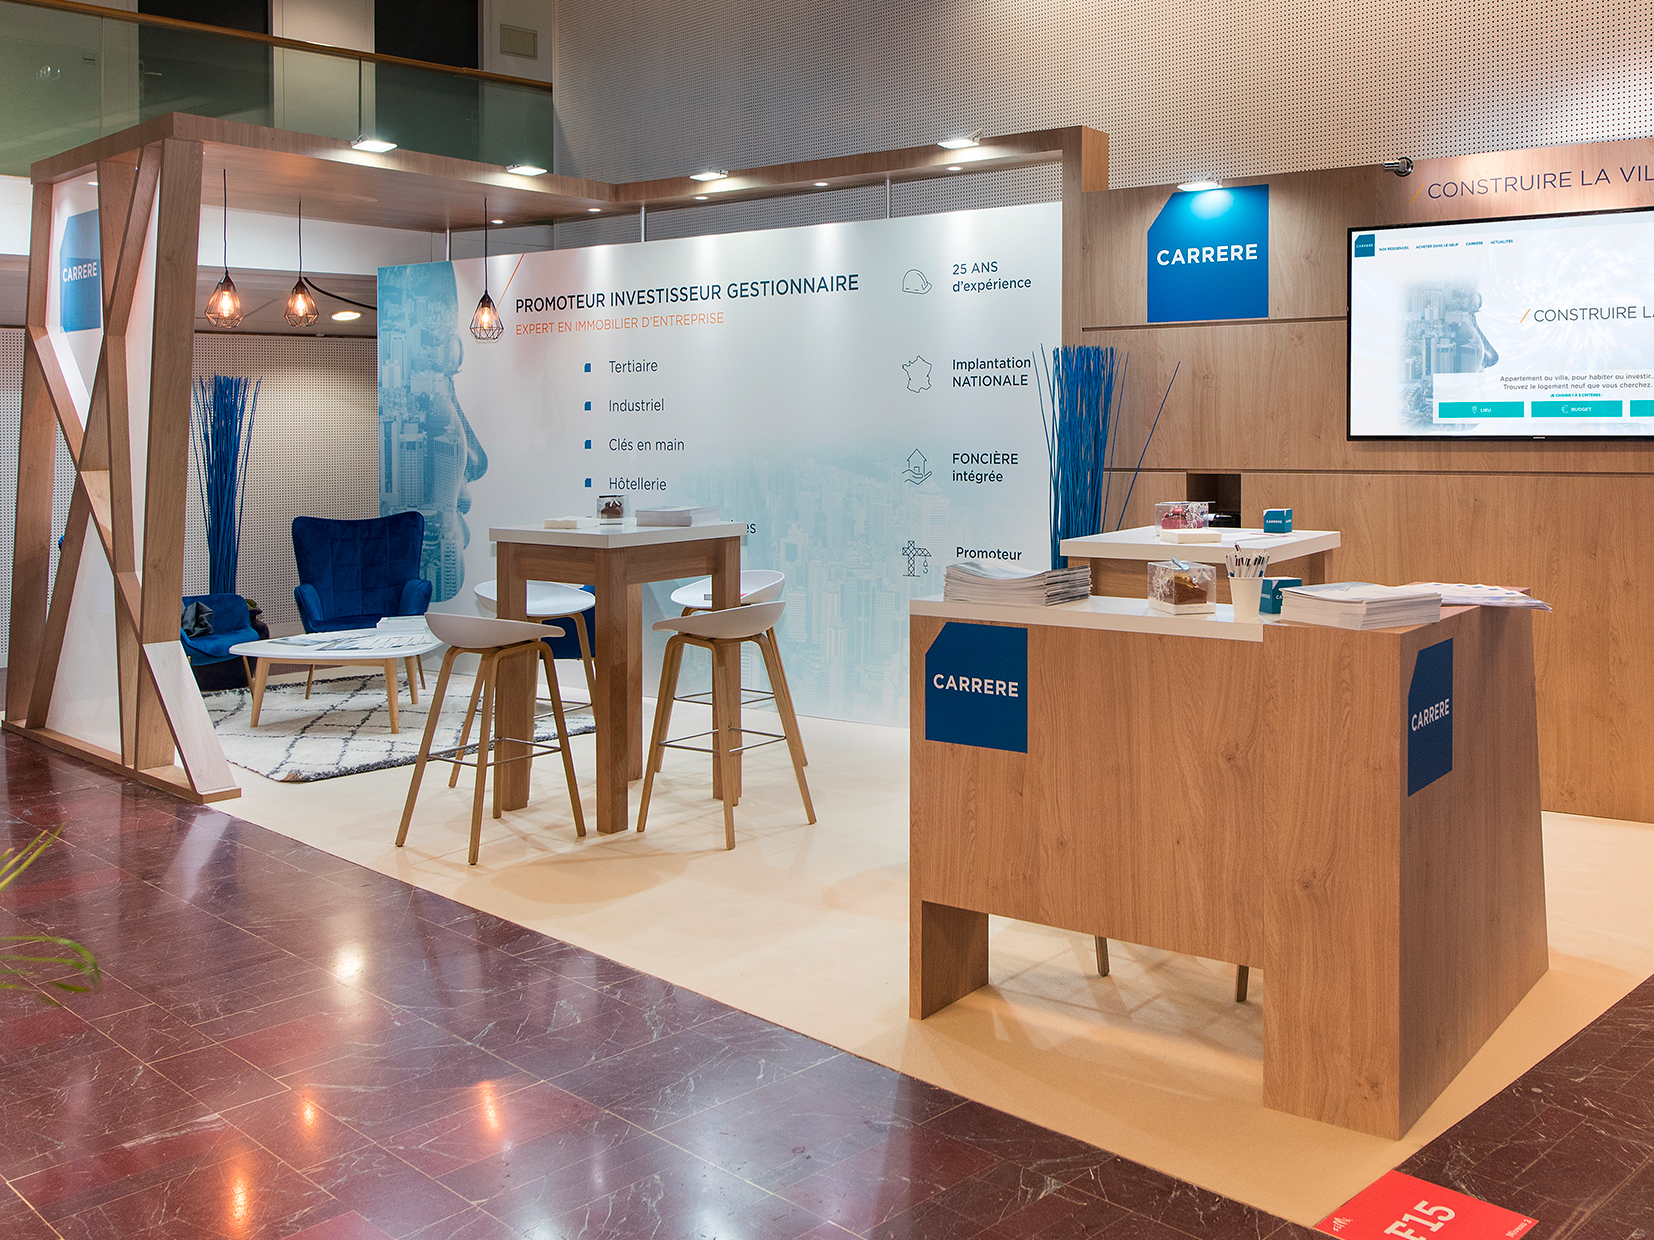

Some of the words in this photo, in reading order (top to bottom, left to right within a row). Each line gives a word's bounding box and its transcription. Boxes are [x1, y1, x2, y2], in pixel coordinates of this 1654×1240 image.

[1428, 171, 1572, 199] CONSTRUIRE
[1581, 168, 1611, 186] LA
[1156, 243, 1258, 266] CARRERE
[62, 261, 98, 283] CARRERE
[952, 263, 967, 275] 25
[971, 260, 998, 274] ANS
[952, 277, 1032, 293] d'expérience
[515, 292, 606, 314] PROMOTEUR
[610, 284, 722, 308] INVESTISSEUR
[726, 273, 859, 299] GESTIONNAIRE
[1533, 305, 1637, 323] CONSTRUIRE
[1643, 305, 1654, 319] L
[515, 322, 555, 335] EXPERT
[557, 321, 572, 333] EN
[575, 317, 639, 332] IMMOBILIER
[641, 311, 724, 328] D'ENTREPRISE
[608, 359, 659, 374] Tertiaire
[952, 356, 1032, 372] Implantation
[952, 374, 1029, 388] NATIONALE
[1500, 375, 1543, 383] Appartement
[1554, 374, 1570, 382] villa,
[1589, 373, 1614, 381] habiter
[1537, 383, 1569, 391] logement
[1619, 381, 1653, 389] cherchez.
[608, 398, 665, 412] Industriel
[608, 438, 634, 451] Clés
[636, 439, 652, 451] en
[655, 437, 685, 451] main
[952, 450, 1019, 465] FONCIÈRE
[608, 477, 667, 491] Hôtellerie
[952, 469, 1004, 484] intégrée
[956, 546, 1023, 561] Promoteur
[933, 673, 1019, 698] CARRERE
[1411, 698, 1450, 732] CARRERE
[1383, 1199, 1456, 1240] F15
